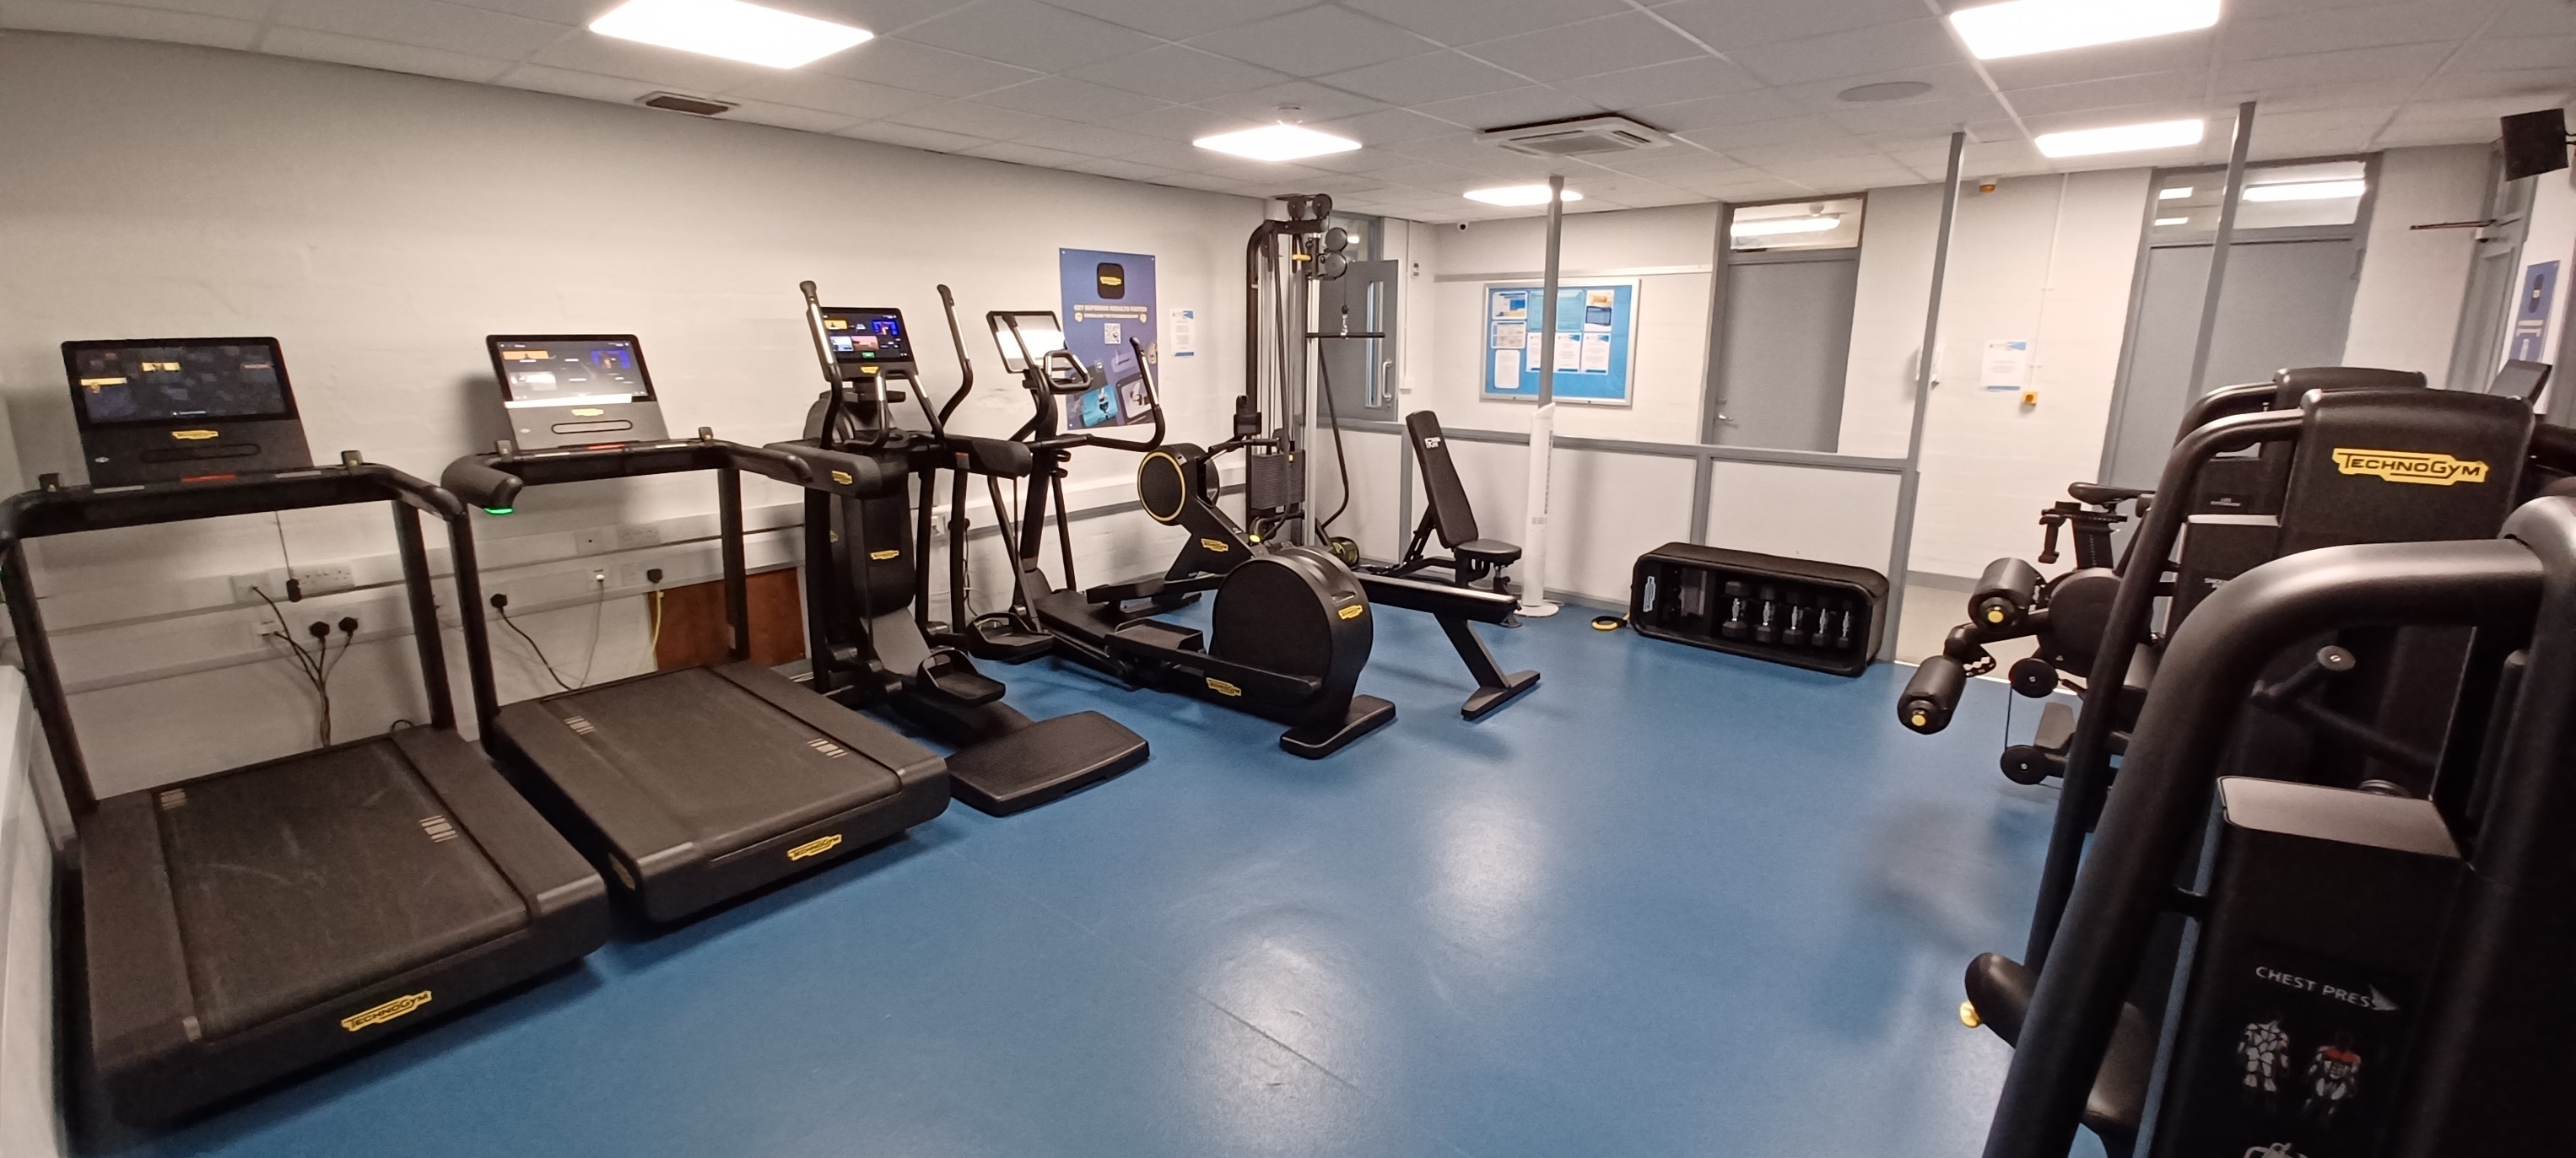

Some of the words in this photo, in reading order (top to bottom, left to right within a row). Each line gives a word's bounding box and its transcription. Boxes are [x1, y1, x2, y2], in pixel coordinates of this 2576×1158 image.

[2336, 451, 2481, 480] TECHNOGYM
[2255, 966, 2316, 991] CHEST
[343, 992, 429, 1029] TECHNOGYM
